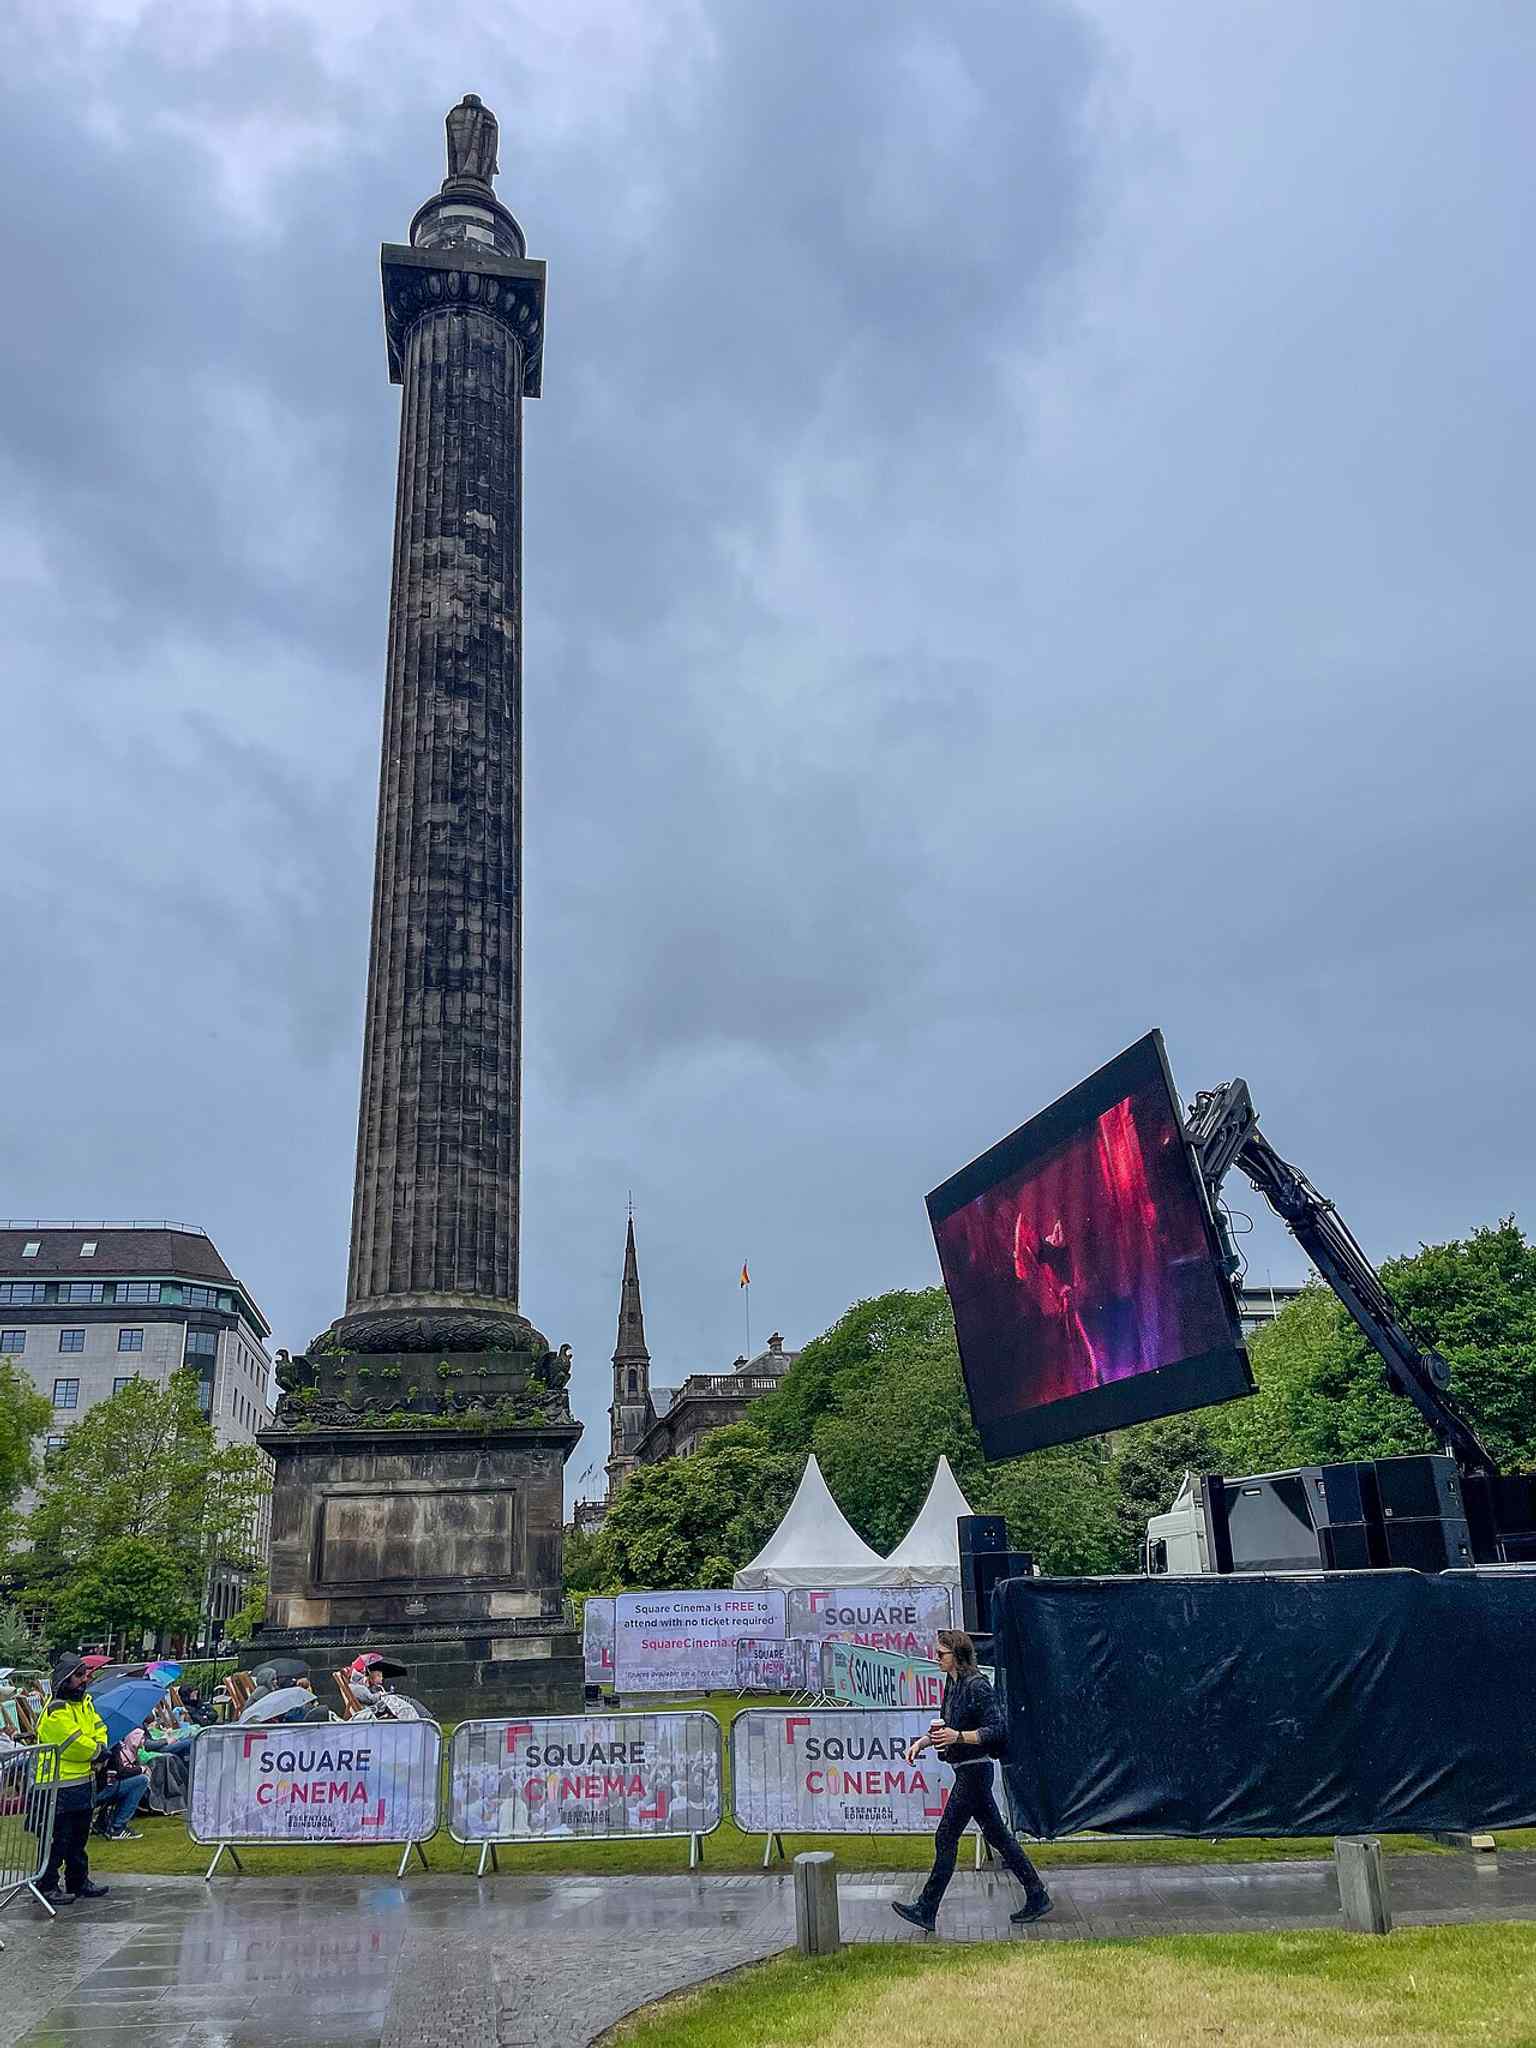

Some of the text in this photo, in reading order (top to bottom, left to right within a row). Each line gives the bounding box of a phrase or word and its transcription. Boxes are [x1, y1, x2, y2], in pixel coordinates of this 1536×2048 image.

[634, 1602, 768, 1615] Square Cinema is FREE to
[825, 1606, 917, 1626] SQUARE
[624, 1618, 658, 1628] attend
[659, 1617, 682, 1627] with
[685, 1619, 698, 1627] no
[700, 1616, 729, 1627] ticket
[753, 1649, 785, 1660] SQUARE
[855, 1658, 897, 1706] SQUARE
[260, 1749, 371, 1773] SQUARE
[526, 1741, 646, 1768] SQUARE
[806, 1765, 930, 1795] CINEMA
[844, 1806, 893, 1814] ESSENTIAL
[844, 1812, 893, 1820] EDINBURGH
